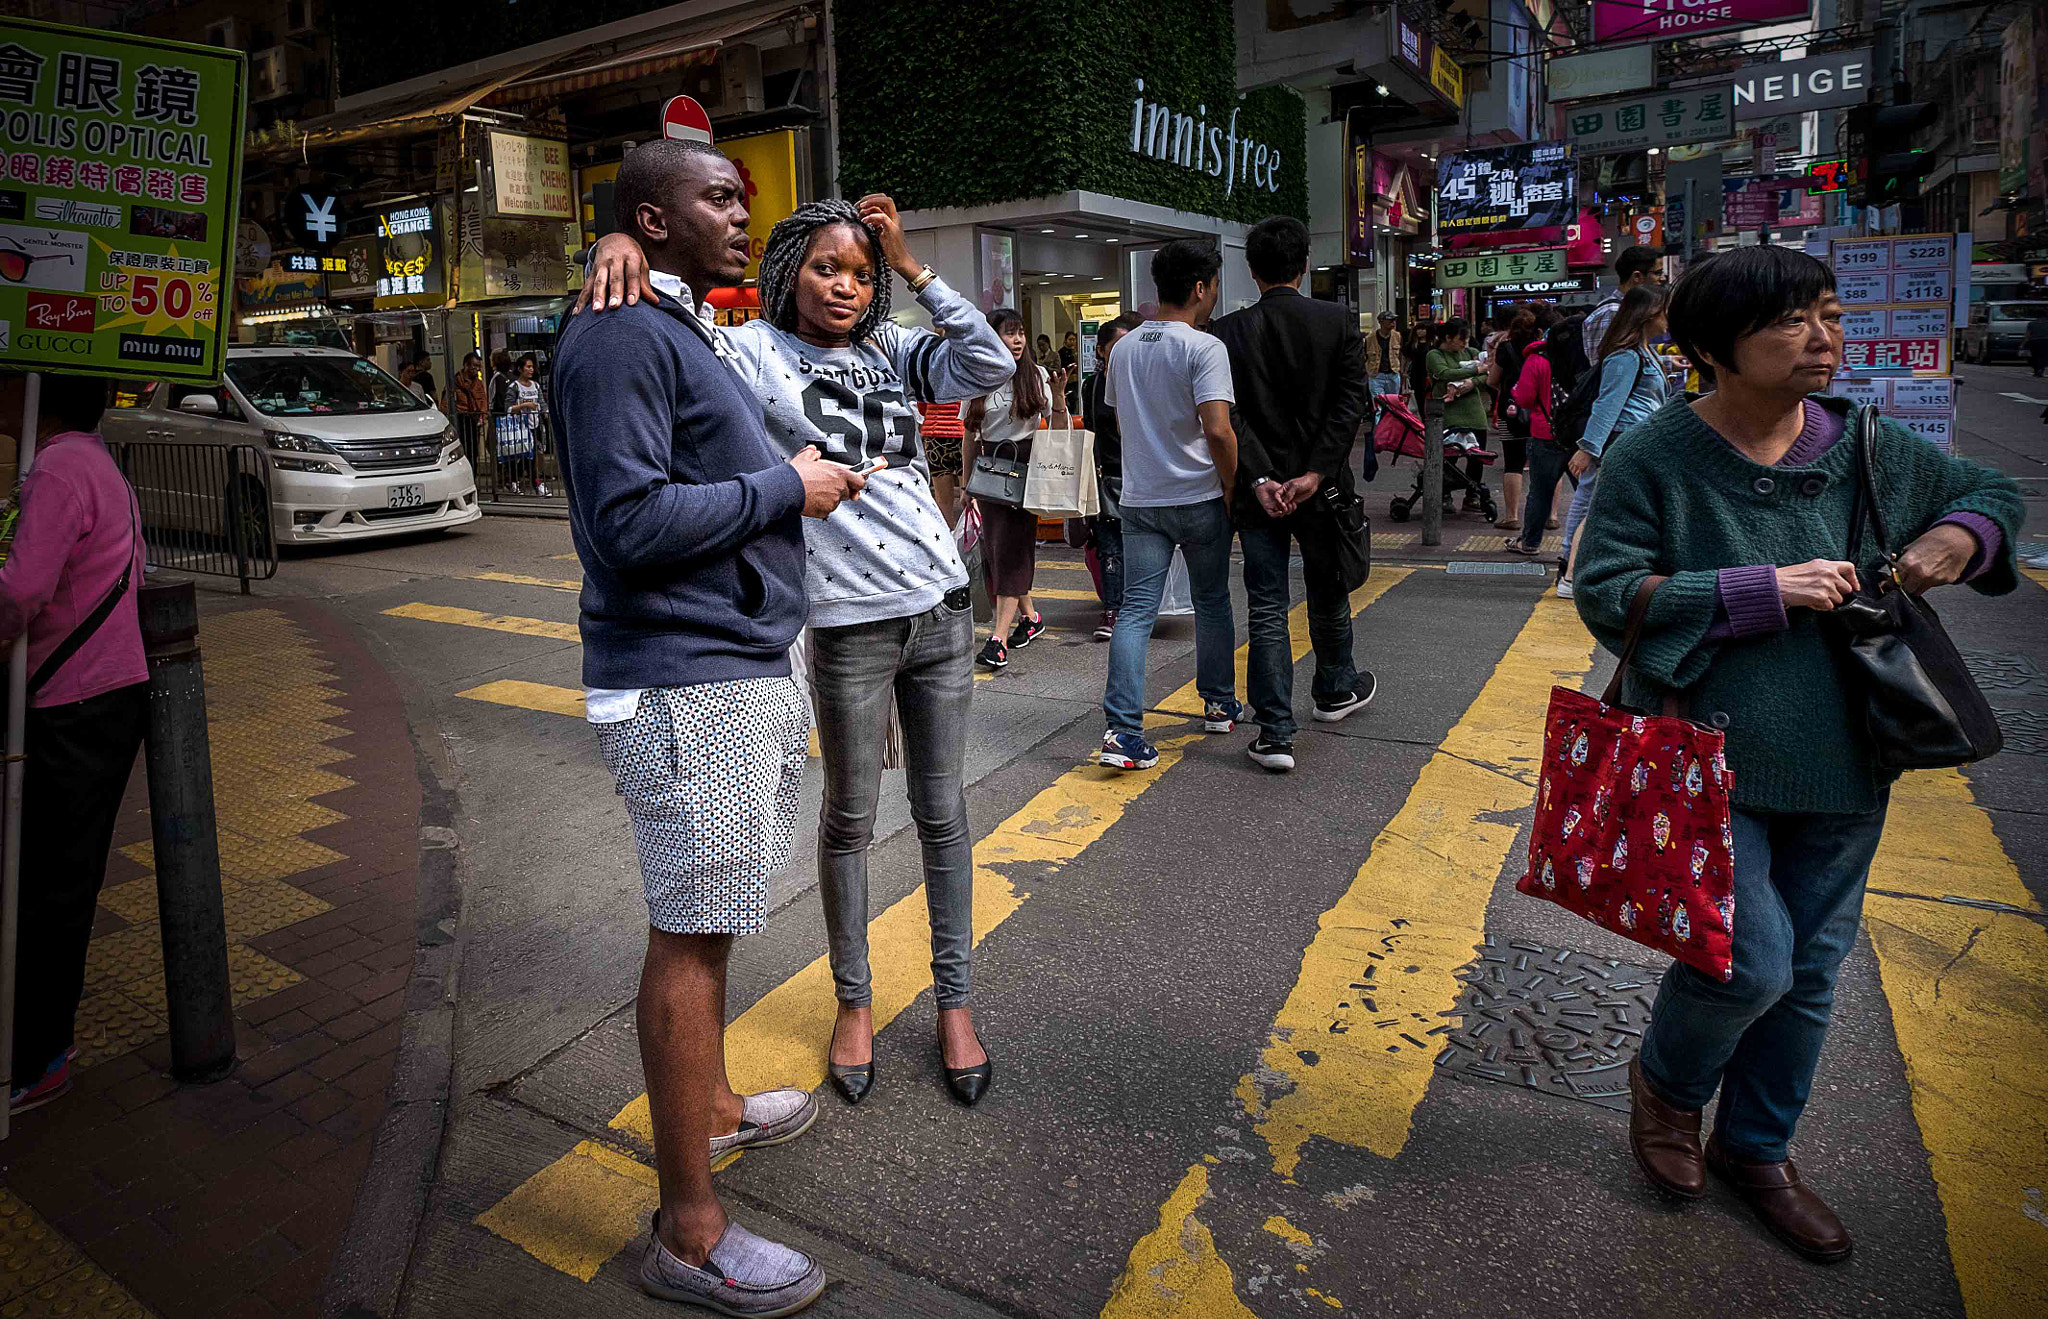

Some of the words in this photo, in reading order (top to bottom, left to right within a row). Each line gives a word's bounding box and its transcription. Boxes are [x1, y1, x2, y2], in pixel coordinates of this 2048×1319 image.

[1660, 6, 1732, 30] HOUSE
[0, 43, 201, 126] 會眼鏡
[1733, 62, 1863, 107] NEIGE
[1572, 92, 1727, 136] 田園書屋
[84, 120, 213, 168] OPTICAL
[1131, 77, 1281, 201] innisfree
[541, 169, 567, 189] CHENG
[1440, 176, 1476, 201] 45
[503, 195, 532, 209] Welcome
[533, 200, 540, 209] to
[543, 193, 568, 212] HIANG
[36, 200, 121, 229] Silhouette
[389, 209, 410, 222] HONG
[410, 207, 430, 219] KONG
[378, 215, 432, 239] EXCHANGE
[23, 238, 49, 246] GENTLE
[50, 241, 84, 249] MONSTER
[1909, 247, 1946, 259] $228
[108, 250, 209, 275] 保證原裝正貨
[1445, 253, 1559, 278] 田園書屋
[1842, 253, 1877, 264] $199
[101, 272, 129, 290] UP
[1495, 283, 1520, 292] SALON
[1552, 281, 1579, 290] AHEAD
[130, 275, 193, 320] 50
[1844, 289, 1868, 300] $88
[1906, 285, 1944, 299] $118
[100, 293, 126, 312] TO
[28, 299, 93, 328] Ray-Ban
[193, 308, 214, 322] off
[1852, 325, 1880, 336] $149
[1917, 323, 1946, 334] $162
[17, 333, 93, 355] GUCCI
[1843, 341, 1936, 368] 登記站
[1919, 395, 1949, 405] $153
[801, 378, 918, 470] SG
[1907, 422, 1946, 434] $145
[398, 485, 413, 497] TK
[390, 495, 422, 508] 2792
